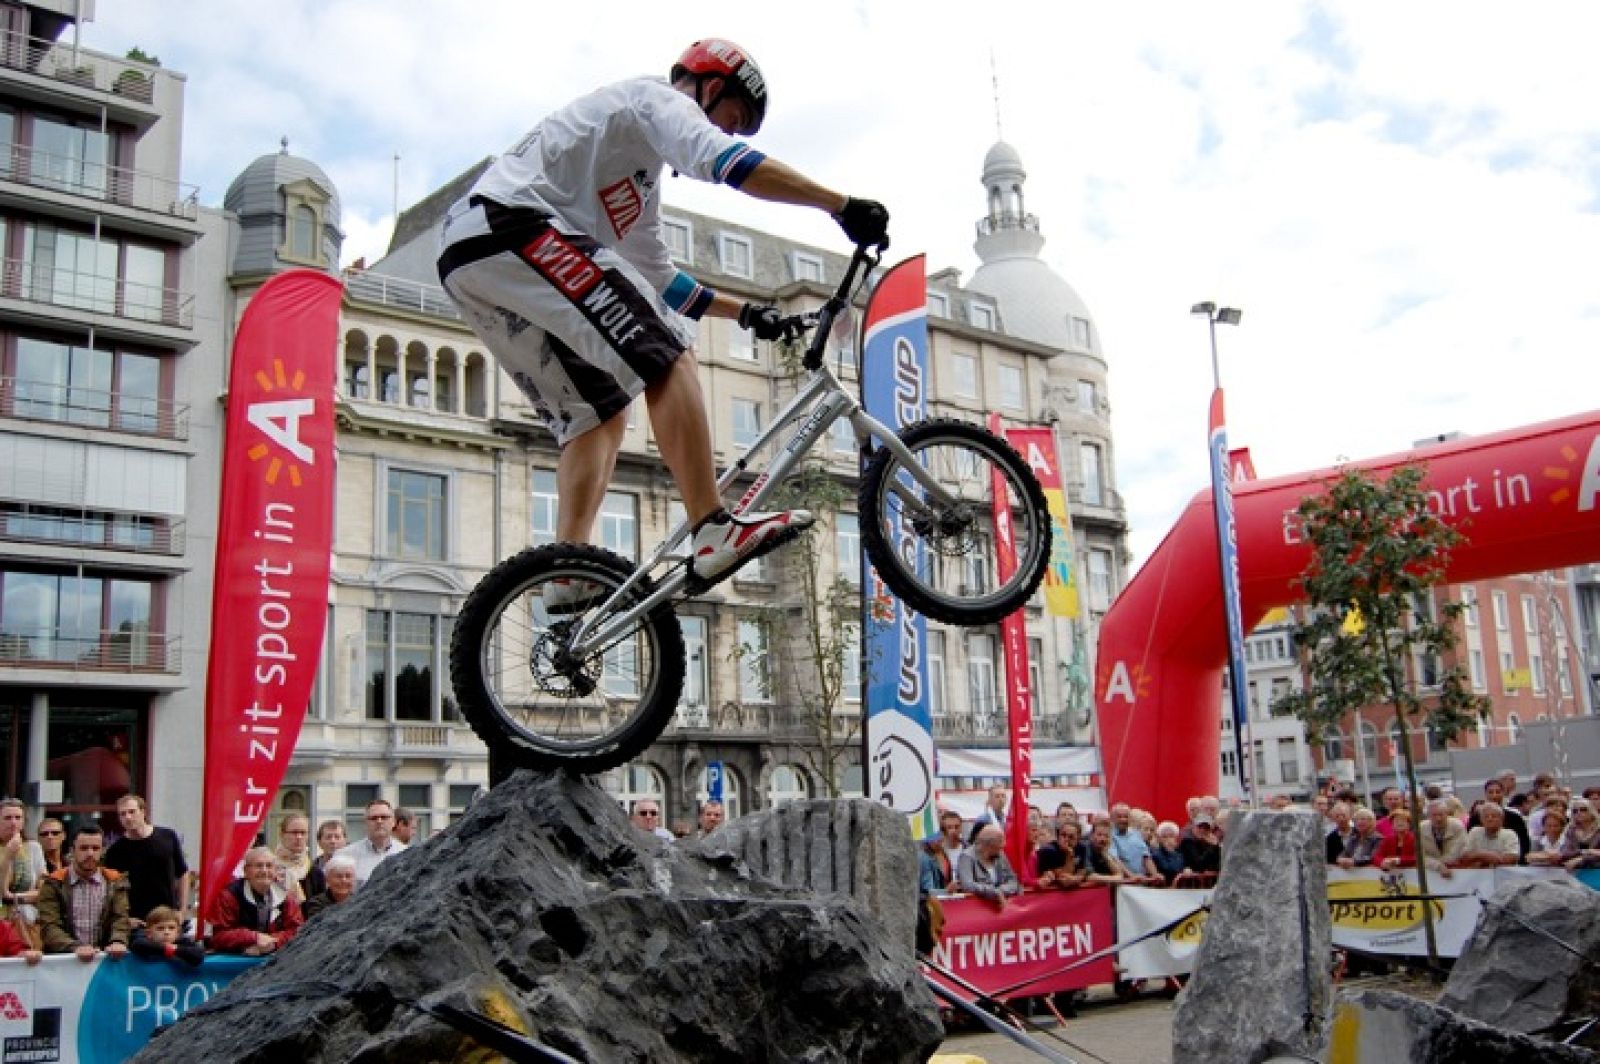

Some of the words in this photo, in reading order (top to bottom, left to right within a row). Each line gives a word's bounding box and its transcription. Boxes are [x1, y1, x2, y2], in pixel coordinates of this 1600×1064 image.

[531, 234, 595, 292] WILD
[583, 280, 645, 345] WOLF
[247, 398, 316, 466] A
[1027, 442, 1053, 475] A
[1493, 468, 1531, 510] in
[253, 502, 295, 544] in
[254, 557, 298, 686] sport
[1104, 660, 1136, 703] A
[239, 701, 283, 761] zit
[234, 777, 268, 823] Er
[707, 767, 719, 792] P
[1331, 902, 1417, 923] psport
[931, 922, 1094, 974] NTWERPEN
[125, 982, 218, 1033] PRO
